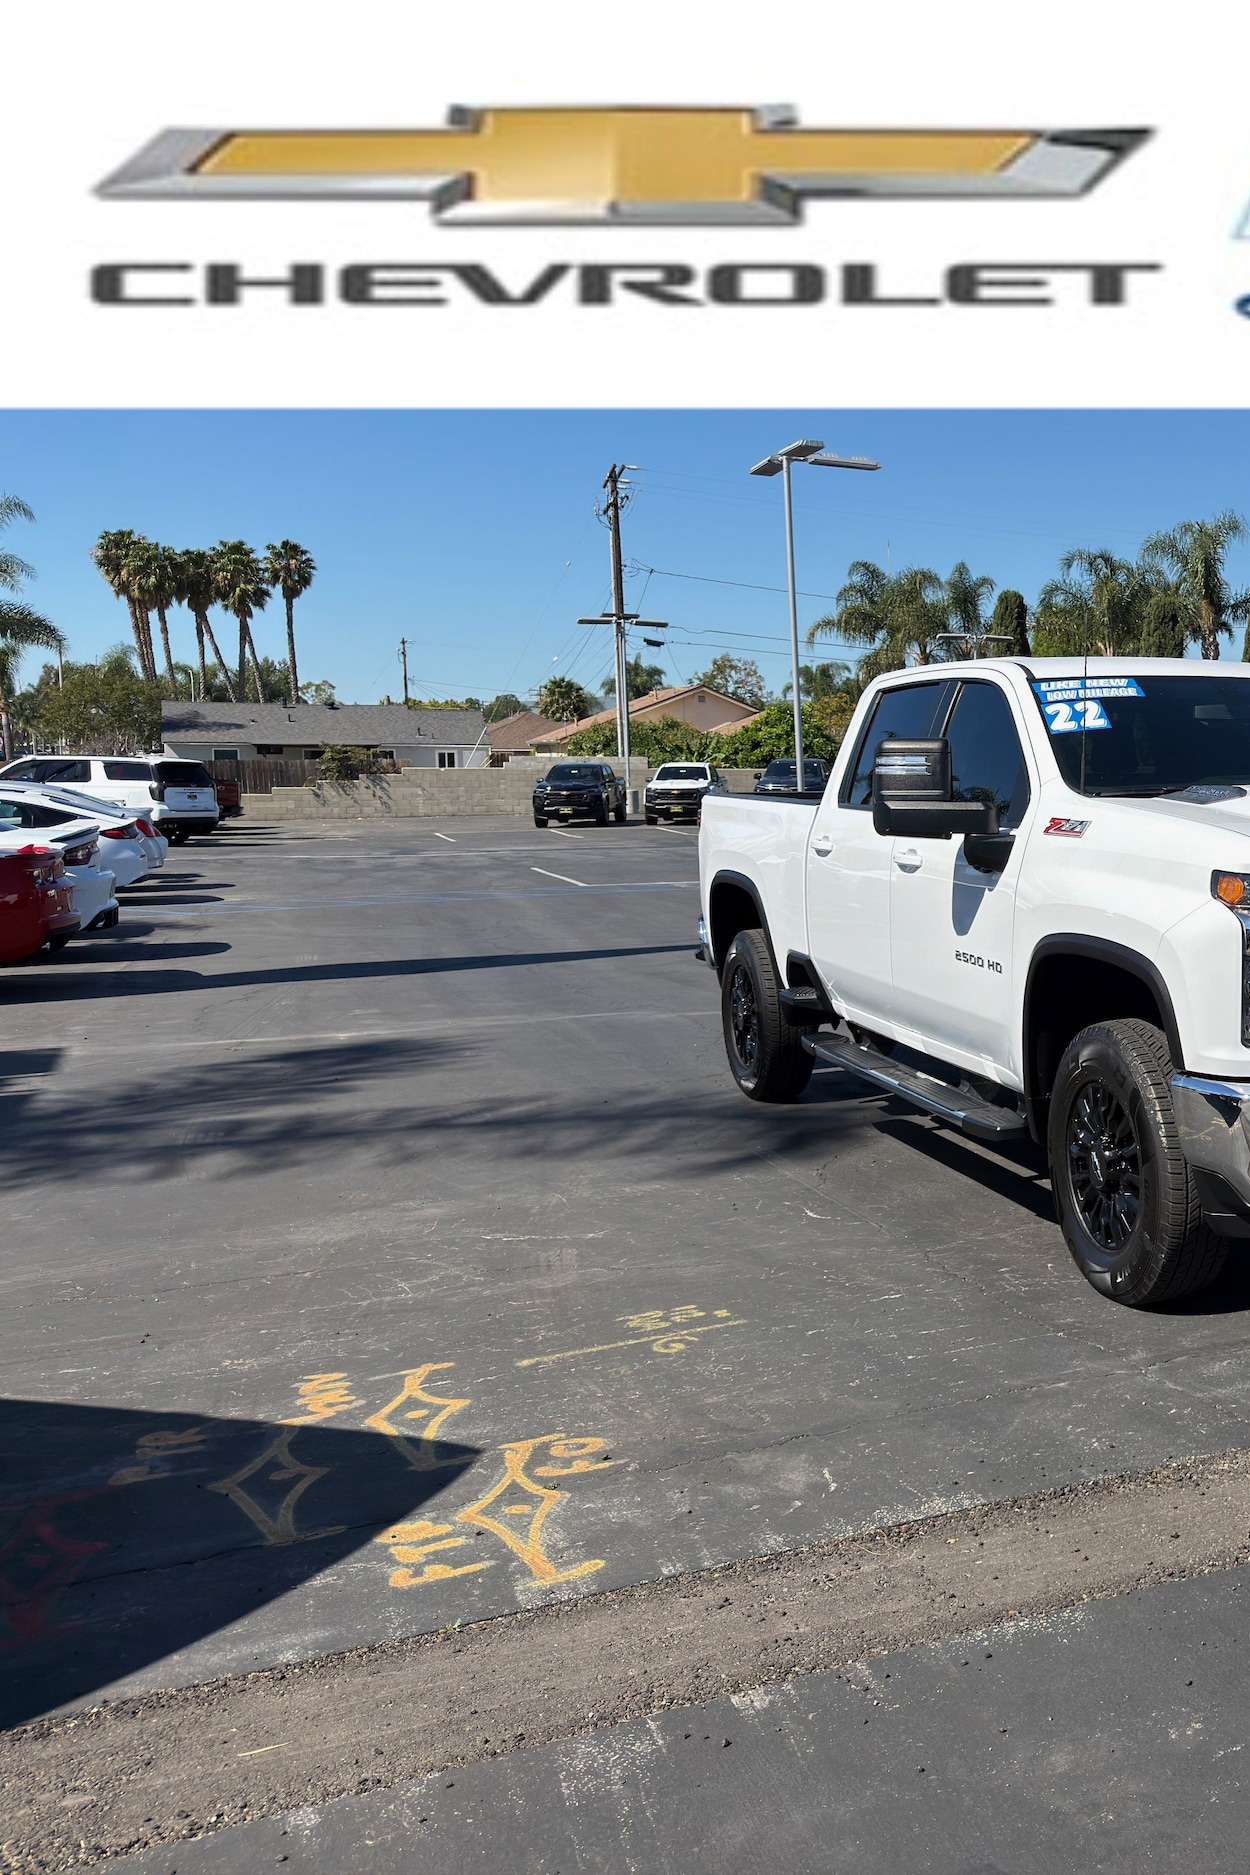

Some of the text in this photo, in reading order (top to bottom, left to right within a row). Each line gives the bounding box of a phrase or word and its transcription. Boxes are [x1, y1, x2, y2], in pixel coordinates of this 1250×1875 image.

[1040, 678, 1128, 691] LIKE NEW
[1046, 687, 1138, 702] LOW MILEAGE
[1044, 700, 1107, 731] 22
[955, 949, 1003, 975] 2500 HD
